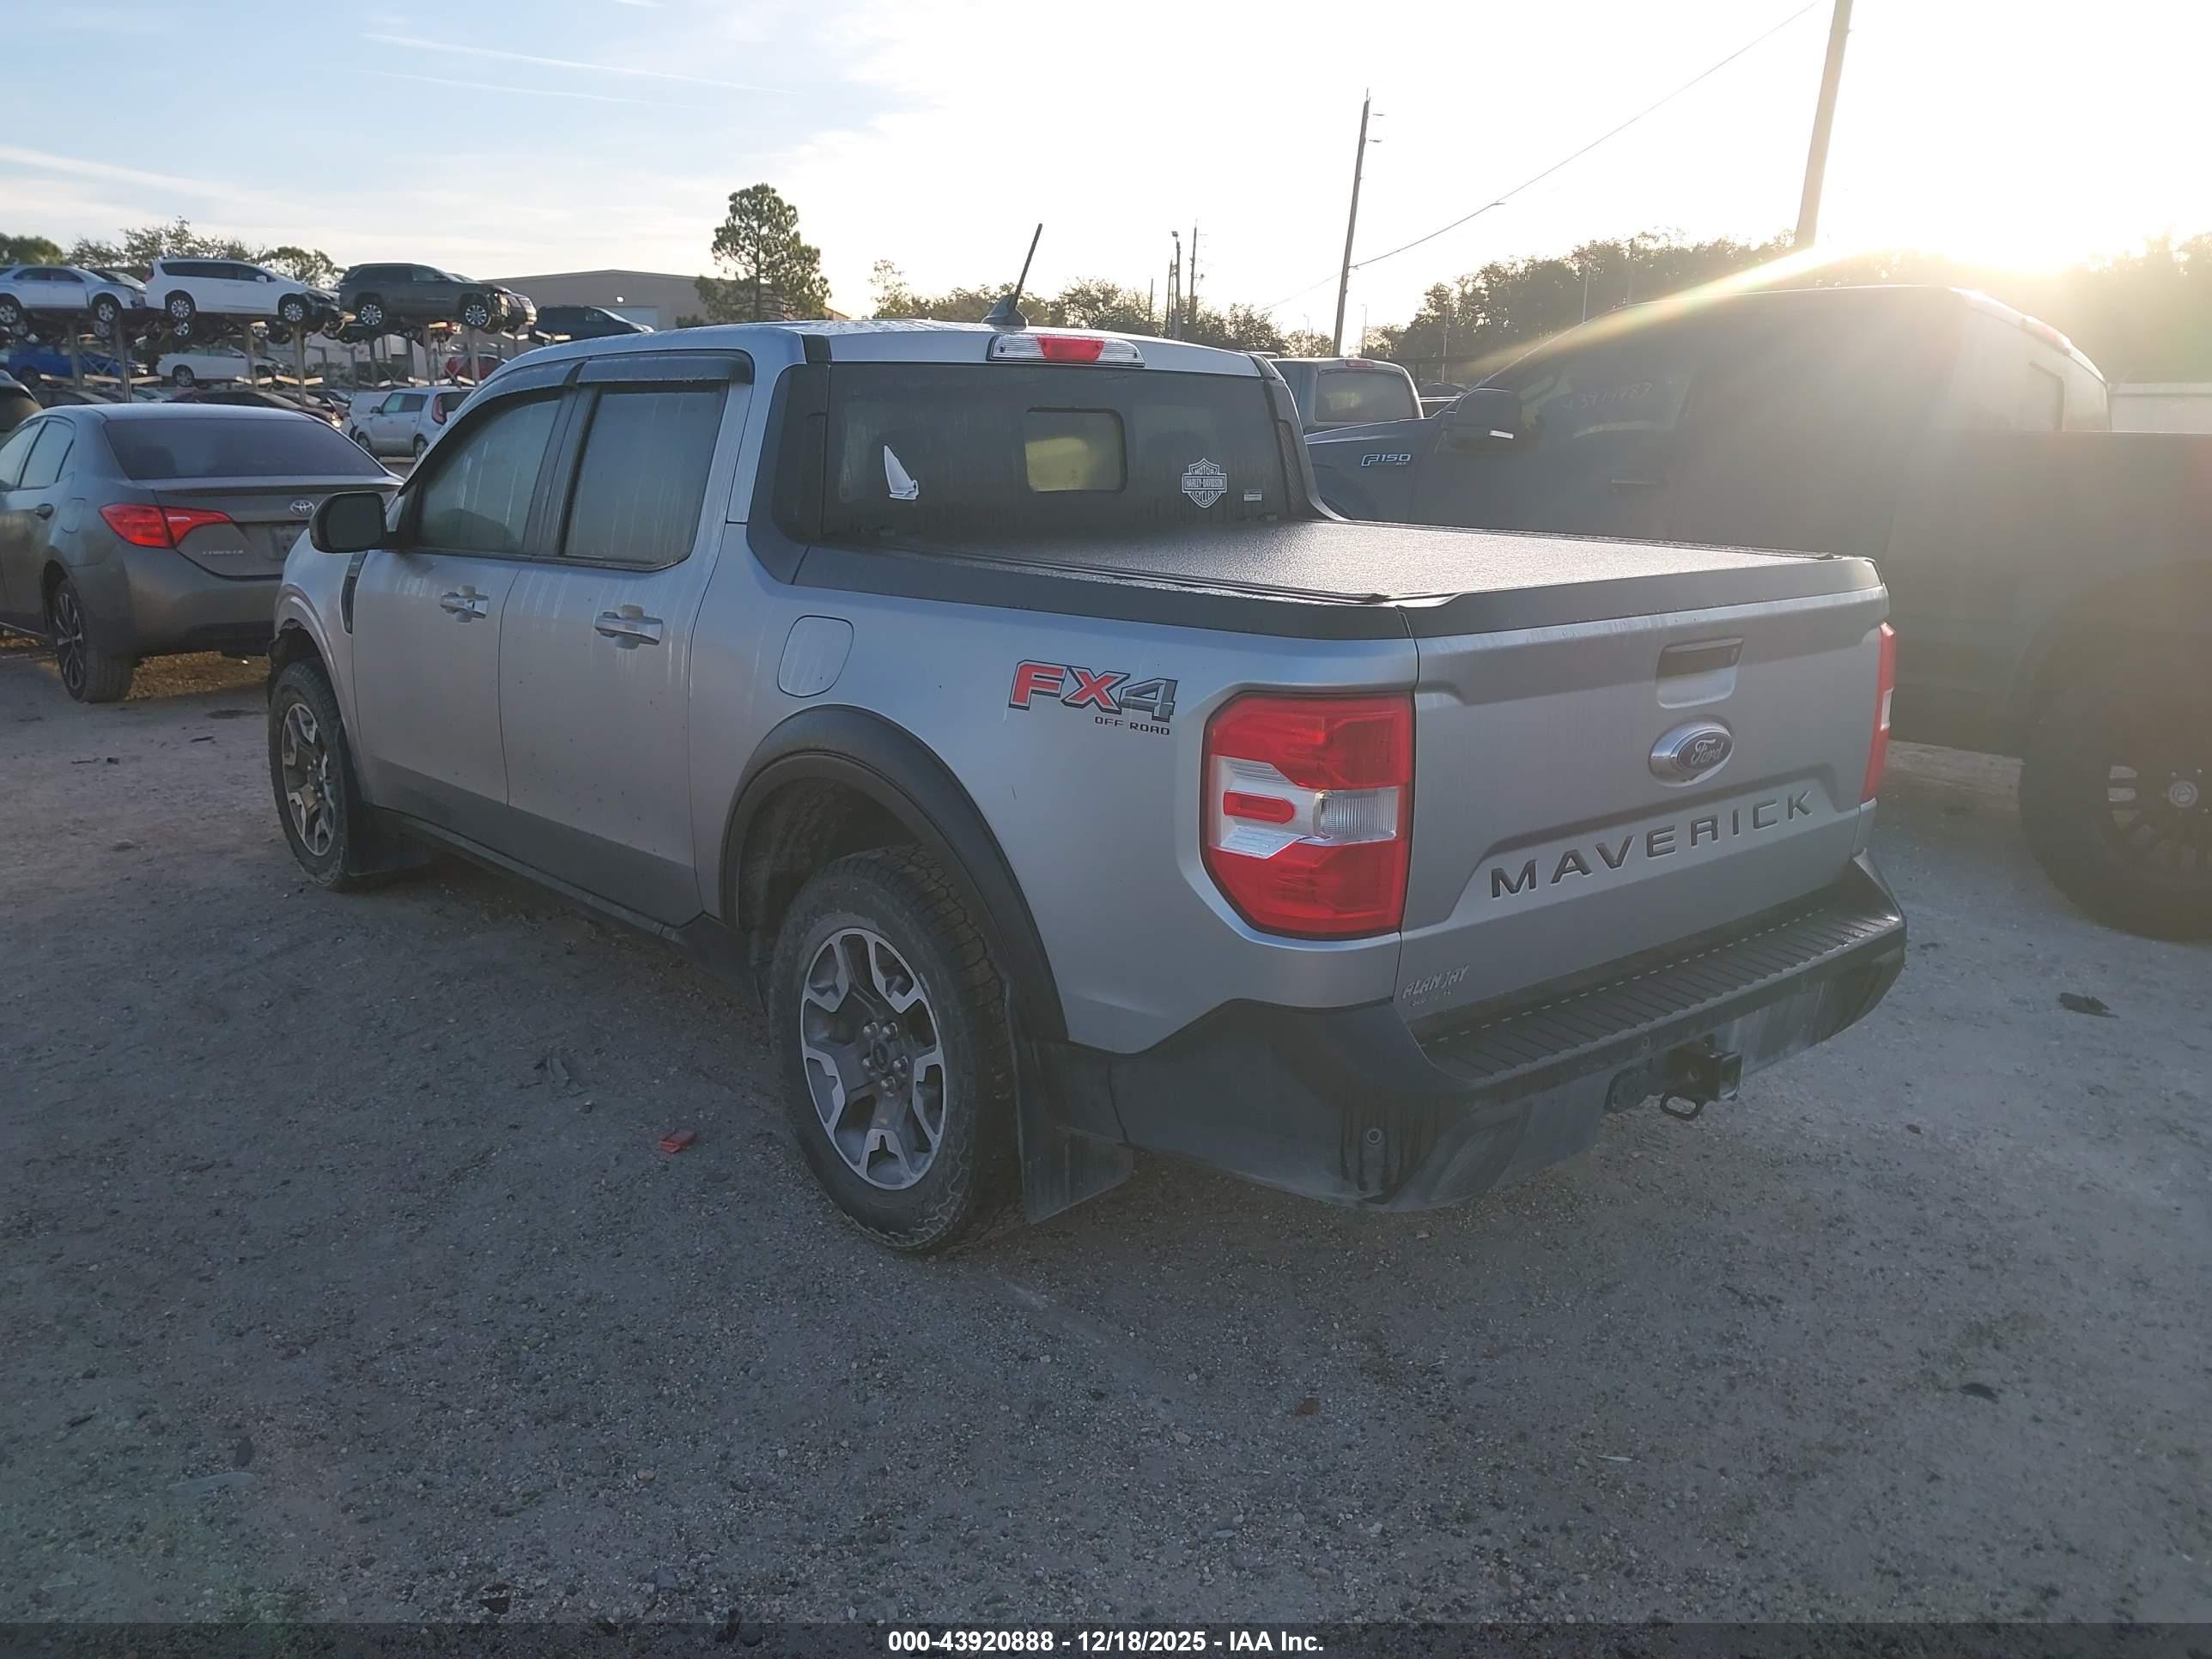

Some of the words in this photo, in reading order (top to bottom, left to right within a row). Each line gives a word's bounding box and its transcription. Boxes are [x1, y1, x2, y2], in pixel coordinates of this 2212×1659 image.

[1194, 465, 1216, 475] MOTOR
[1008, 659, 1178, 723] FX4
[1094, 716, 1124, 727] OFF
[1129, 721, 1170, 736] ROAD
[1690, 738, 1724, 766] Ford
[1490, 790, 1813, 900] MAVERICK
[1401, 973, 1443, 1000] ALAN
[1441, 964, 1470, 989] JAY
